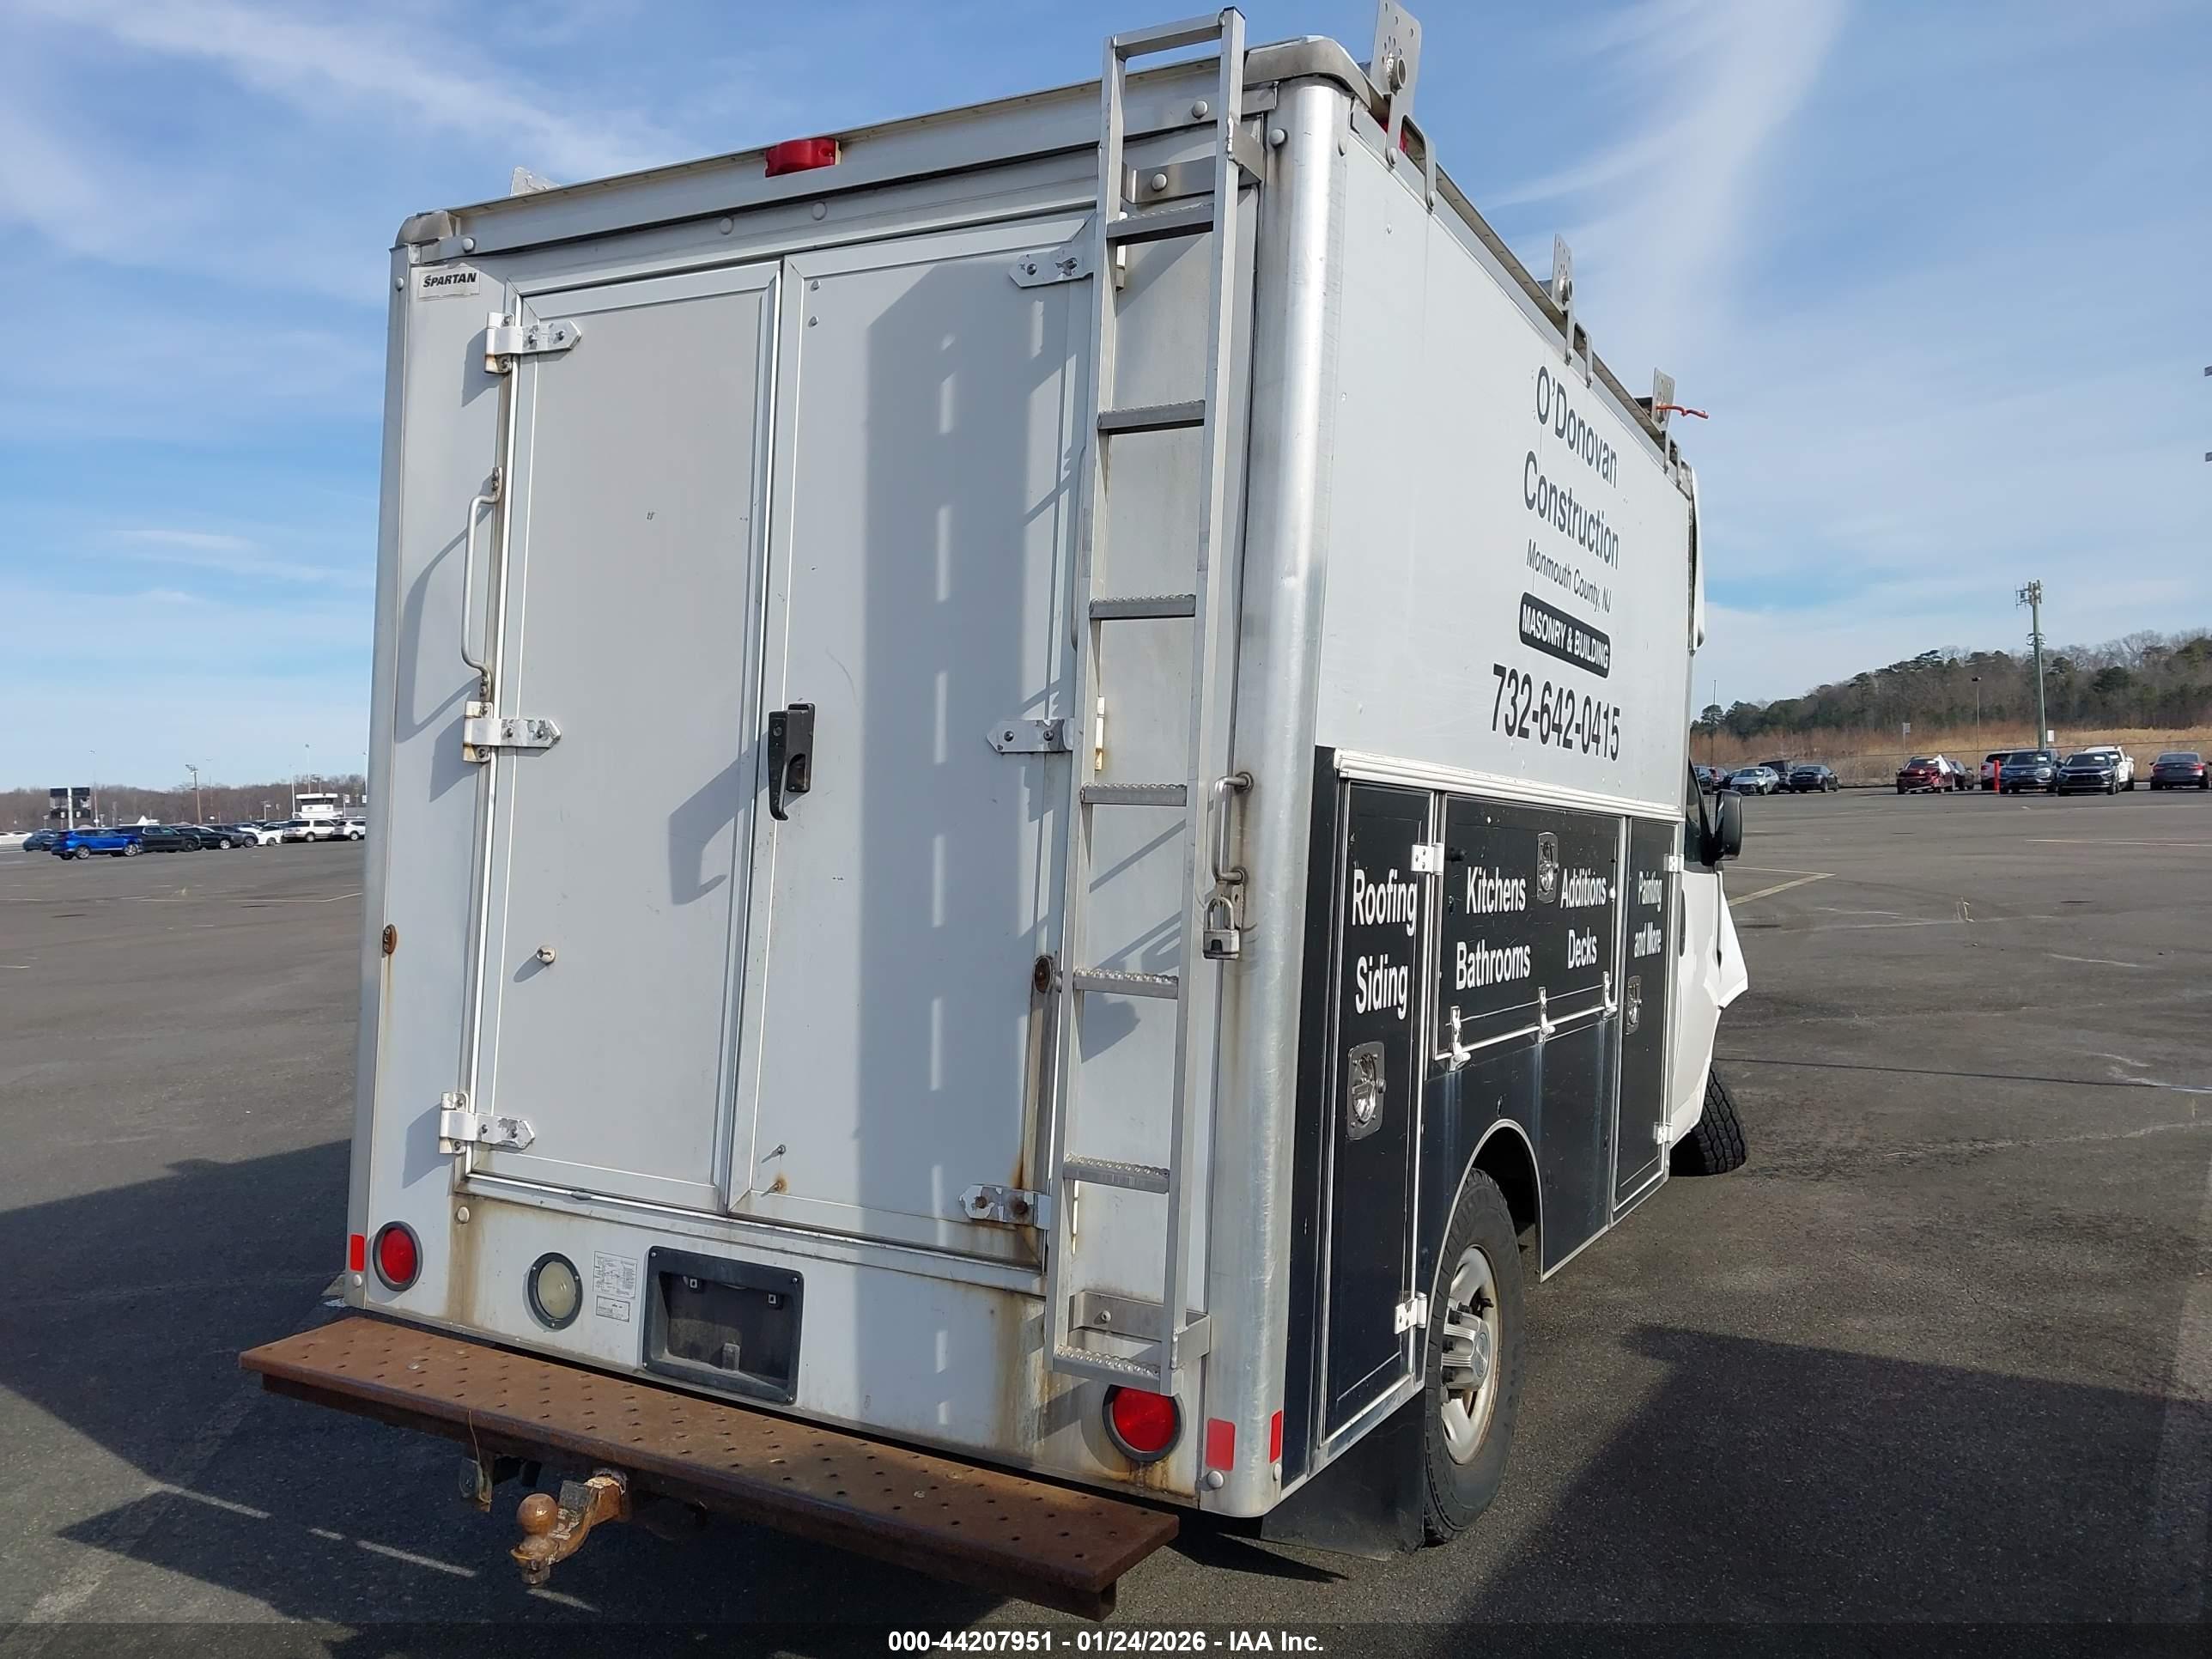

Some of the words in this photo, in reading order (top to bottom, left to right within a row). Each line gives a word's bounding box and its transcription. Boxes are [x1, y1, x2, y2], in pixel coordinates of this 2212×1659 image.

[423, 272, 477, 288] SPARTAN
[1536, 365, 1618, 488] O'Donovan
[1524, 450, 1620, 569] Construction
[1526, 538, 1571, 591] Monmouth
[1573, 568, 1601, 613] County,
[1602, 586, 1612, 614] NJ
[1522, 604, 1566, 650] MASONRY
[1567, 627, 1573, 653] &
[1574, 629, 1608, 669] BUILDING
[1492, 663, 1620, 761] 732-642-0415
[1352, 868, 1417, 937] Roofing
[1466, 866, 1526, 915] Kitchens
[1560, 868, 1607, 909] Additions
[1455, 939, 1531, 990] Bathrooms
[1567, 927, 1597, 969] Decks
[1634, 929, 1646, 958] and
[1355, 954, 1408, 1020] Siding
